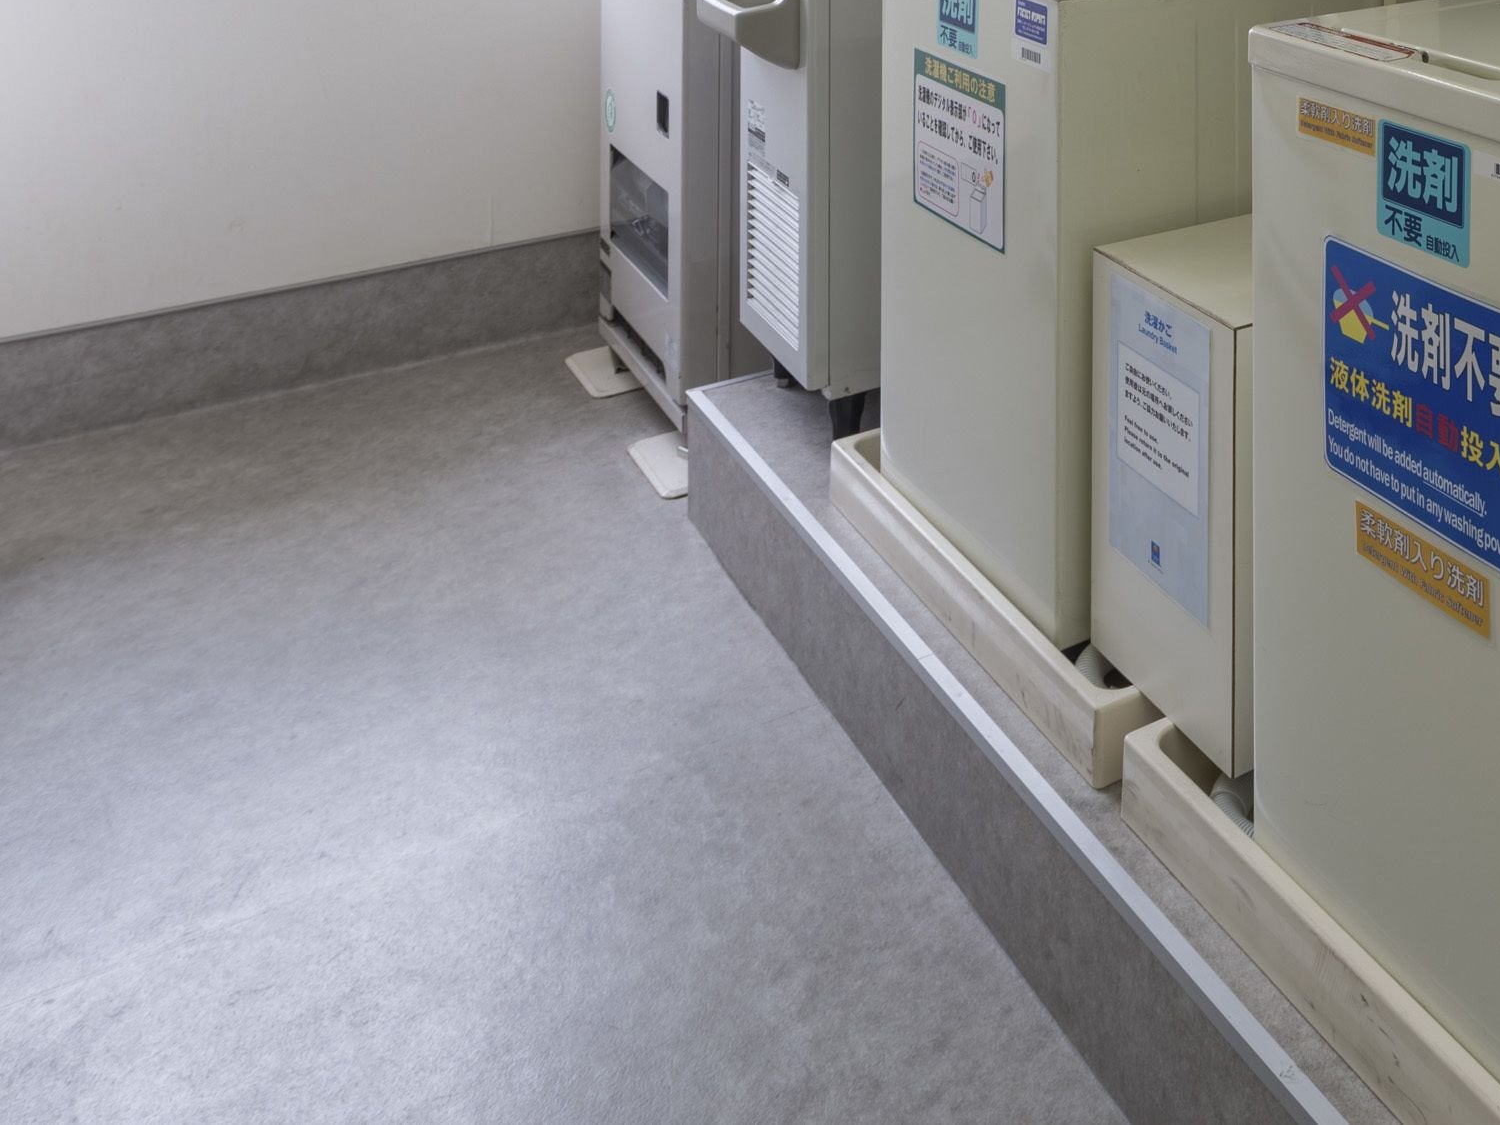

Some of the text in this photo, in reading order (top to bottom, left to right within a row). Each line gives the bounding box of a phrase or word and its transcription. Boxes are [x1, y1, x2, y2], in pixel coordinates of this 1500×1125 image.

[940, 24, 958, 50] 不要
[1300, 98, 1373, 137] 柔軟剤入り洗剤
[1387, 136, 1459, 213] 洗剤
[1384, 203, 1423, 247] 不要
[1426, 234, 1460, 262] 自動投入
[1138, 322, 1178, 355] Laundry Basket
[1144, 309, 1173, 338] 洗濯かご
[1327, 407, 1488, 516] Detergent will be added automatically.
[1328, 434, 1344, 458] You
[1343, 446, 1355, 466] do
[1355, 455, 1370, 474] not
[1369, 460, 1391, 487] have
[1390, 473, 1400, 493] to
[1400, 481, 1416, 503] put
[1416, 487, 1425, 509] in
[1426, 498, 1444, 522] any
[1444, 508, 1485, 548] washing
[1360, 508, 1484, 607] 柔軟剤入り洗剤
